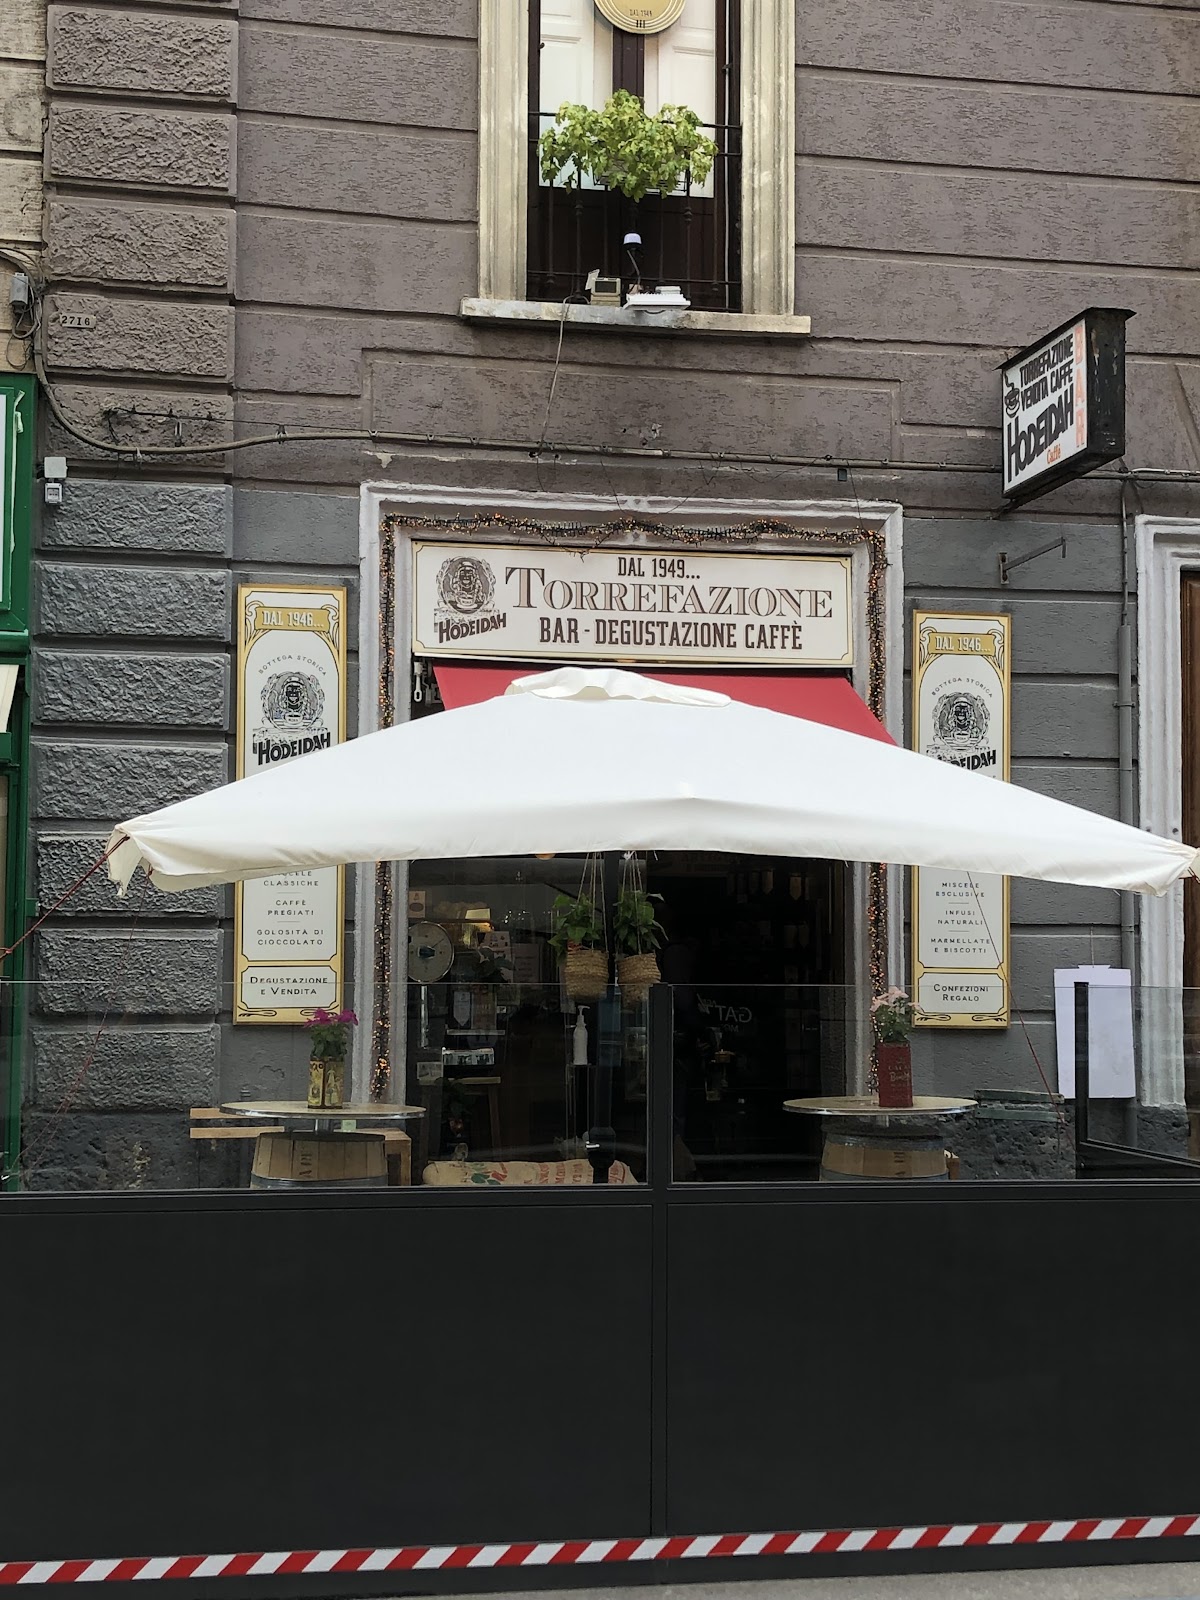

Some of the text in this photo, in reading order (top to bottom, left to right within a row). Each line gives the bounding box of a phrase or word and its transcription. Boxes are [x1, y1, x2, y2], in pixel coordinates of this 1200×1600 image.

[62, 315, 90, 326] 2716
[1020, 333, 1074, 388] TORREFAZIONE
[1020, 377, 1049, 411] VENDITA
[1075, 325, 1085, 448] BAR
[1007, 383, 1074, 483] HODEIDAH
[618, 556, 701, 580] DAL 1949...
[505, 566, 833, 619] TORREFAZIONE
[262, 611, 284, 626] DAL
[438, 613, 508, 644] HODEIDAH
[540, 616, 579, 645] BAR
[595, 619, 737, 648] DEGUSTAZIONE
[745, 619, 802, 651] CAFFÈ
[935, 636, 955, 650] DAL
[258, 655, 327, 676] BOTTEGA STORICA
[931, 677, 993, 698] BOTTEGA STORICA
[258, 732, 331, 766] HODEIDAH
[250, 976, 328, 984] DEGUSTAZIONE
[271, 987, 317, 995] VENDITA
[933, 983, 989, 992] CONFEZIONI
[942, 994, 980, 1002] REGALO
